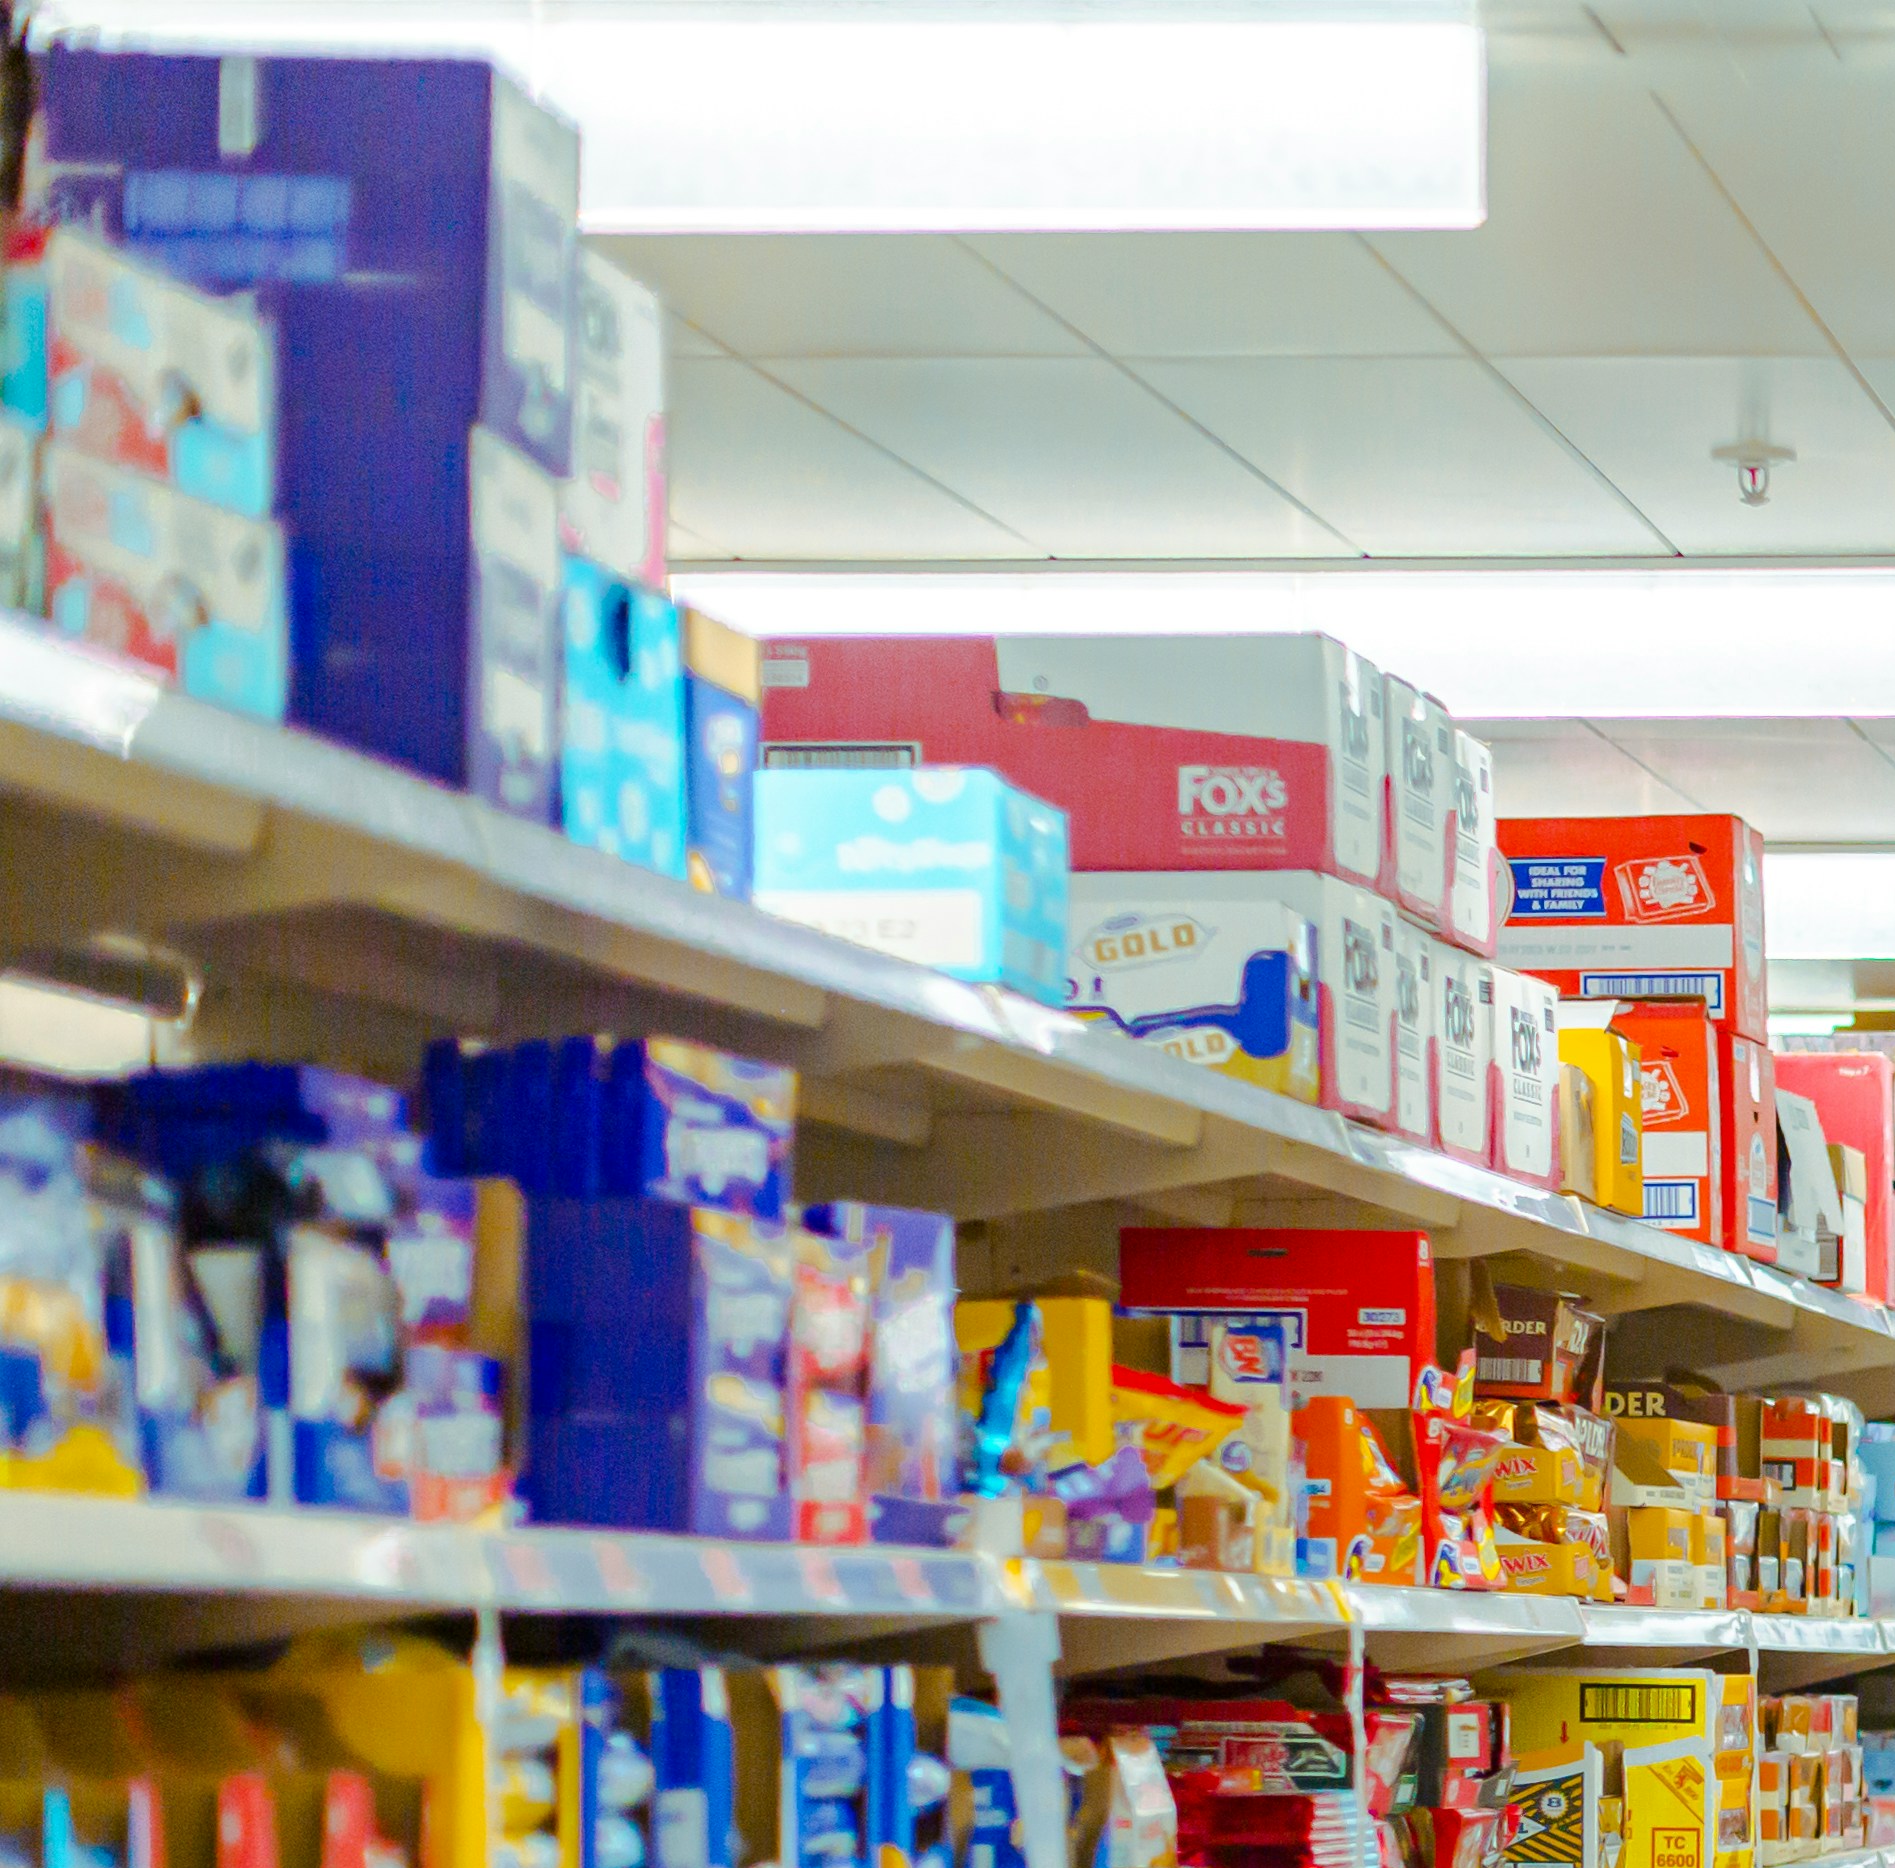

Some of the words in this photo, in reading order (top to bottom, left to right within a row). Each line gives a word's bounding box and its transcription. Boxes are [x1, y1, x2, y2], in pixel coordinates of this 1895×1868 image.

[1093, 923, 1196, 964] GOLD
[1475, 1321, 1547, 1335] RDER
[1606, 1391, 1667, 1417] DER
[1663, 1836, 1687, 1850] TC
[1656, 1853, 1695, 1868] 6600
